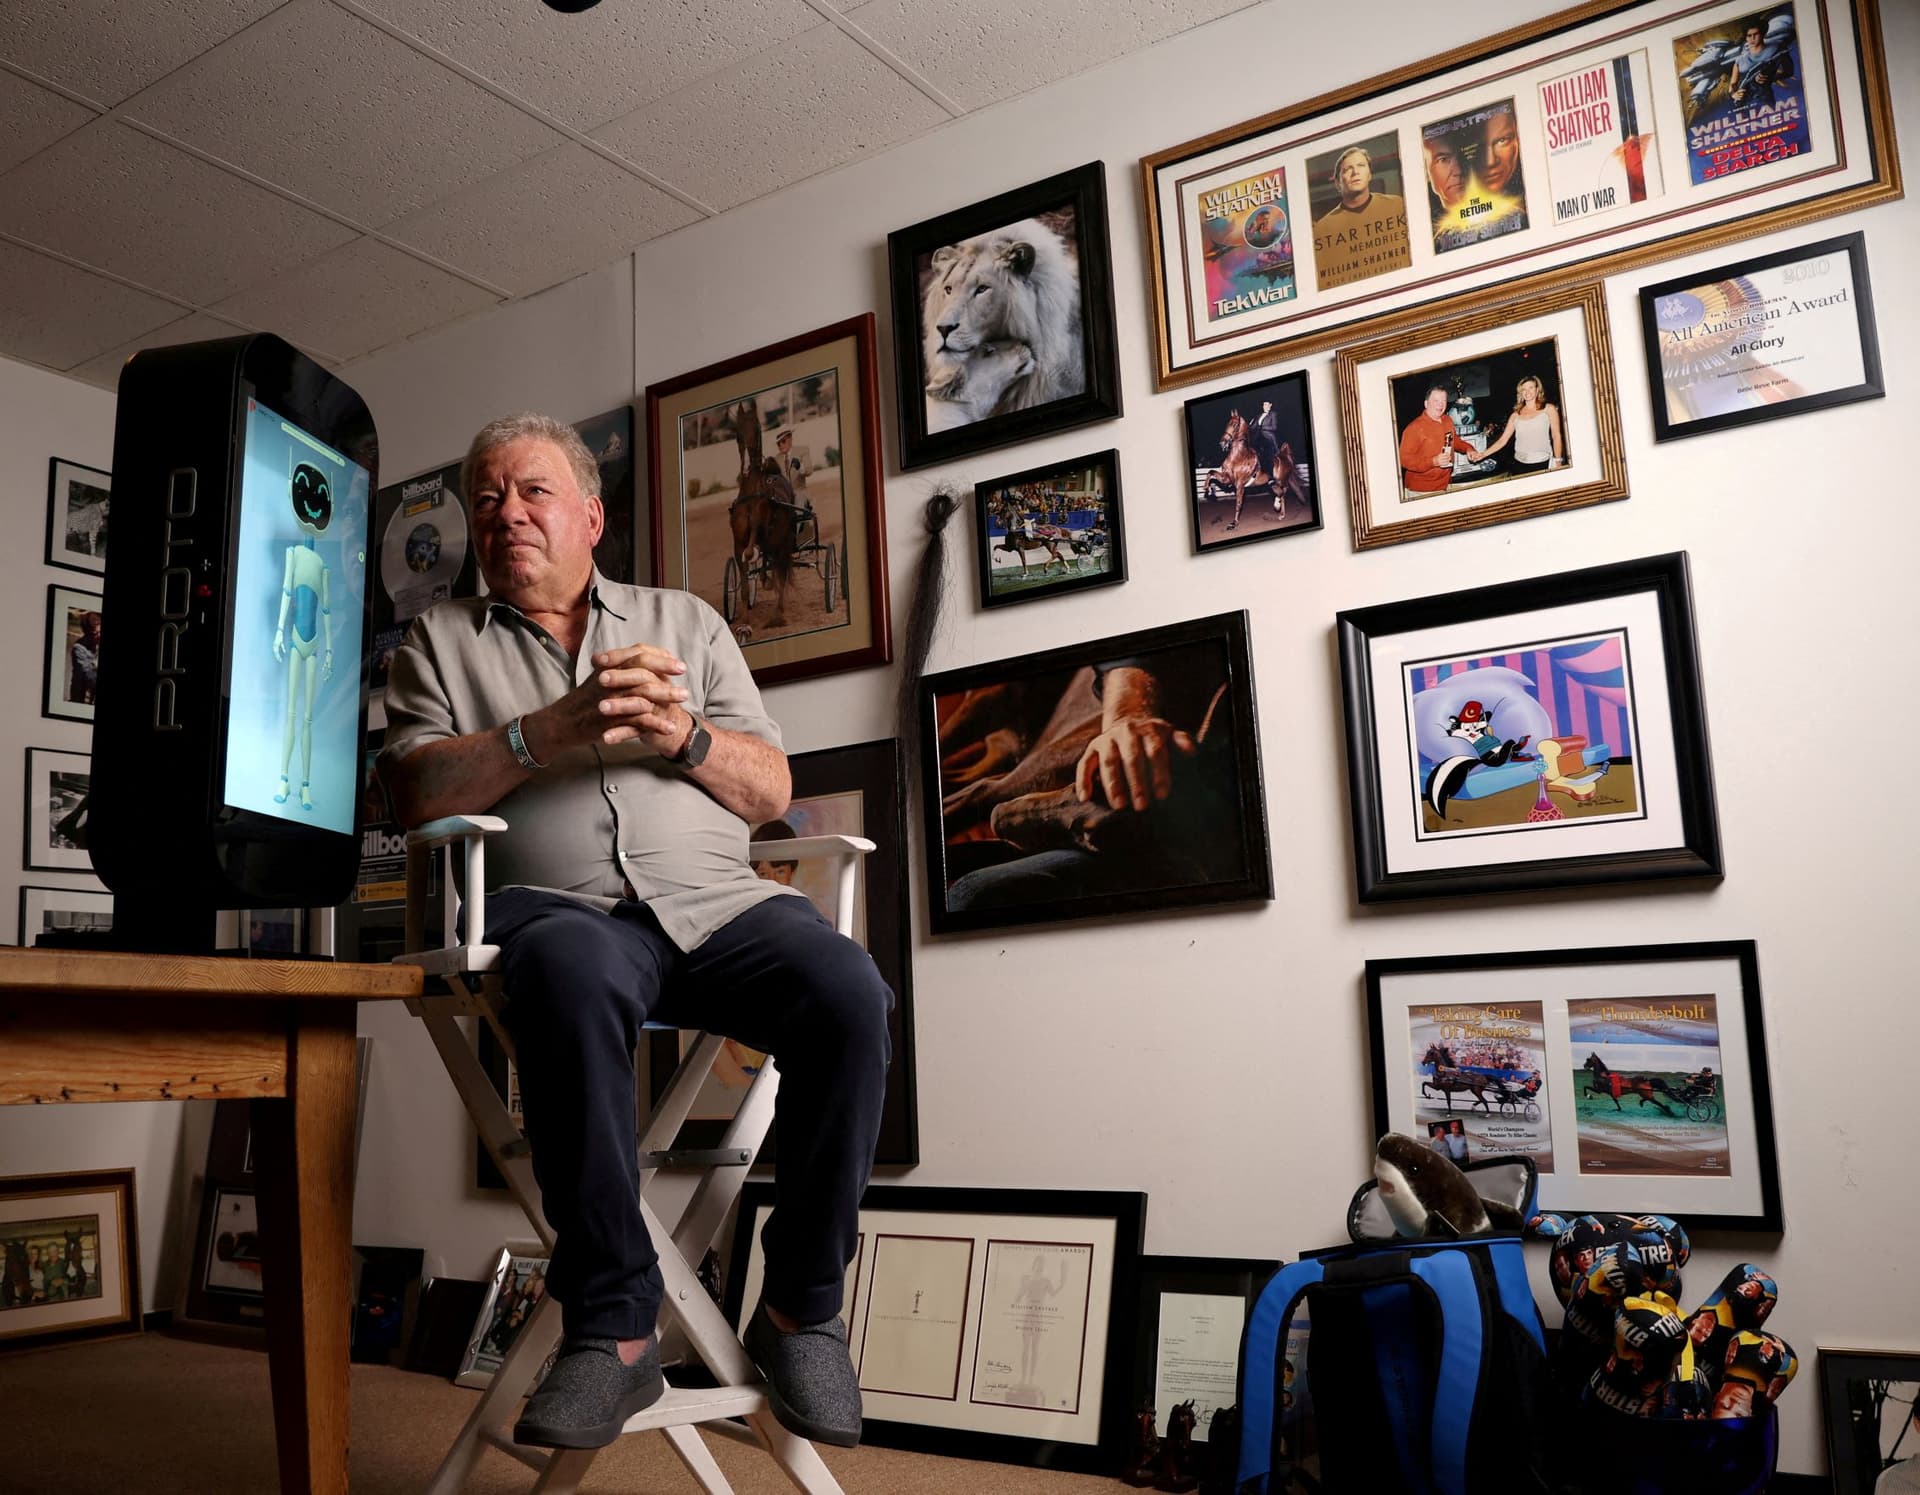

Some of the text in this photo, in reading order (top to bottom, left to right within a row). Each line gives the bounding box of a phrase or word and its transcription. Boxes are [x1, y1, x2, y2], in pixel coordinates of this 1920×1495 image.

[1543, 67, 1608, 116] WILLIAM
[1547, 102, 1612, 149] SHATNER
[1690, 96, 1797, 136] WILLIAM
[1691, 108, 1800, 149] SHATNER
[1703, 143, 1798, 180] SEARCH
[1712, 136, 1785, 165] DELTA
[1205, 174, 1280, 208] WILLIAM
[1206, 187, 1283, 221] SHATNER
[1470, 197, 1480, 206] THE
[1556, 196, 1579, 220] MAN
[1592, 187, 1616, 210] WAR
[1460, 201, 1493, 219] RETURN
[1315, 215, 1407, 251] STAR TREK
[1349, 230, 1407, 254] MEMORIES
[1320, 246, 1406, 278] WILLIAM SHATNER
[1214, 285, 1293, 317] TekWar
[1669, 327, 1693, 344] All
[1700, 308, 1780, 336] American
[1787, 288, 1848, 315] Award
[1731, 336, 1785, 356] All Glory
[402, 473, 443, 498] billboard
[154, 467, 197, 732] PROTO
[362, 830, 408, 857] illbo
[1431, 1005, 1521, 1025] Taking Care
[1600, 1003, 1707, 1021] Thunderbolt
[1464, 1023, 1532, 1040] Business
[1638, 1244, 1672, 1265] TRE
